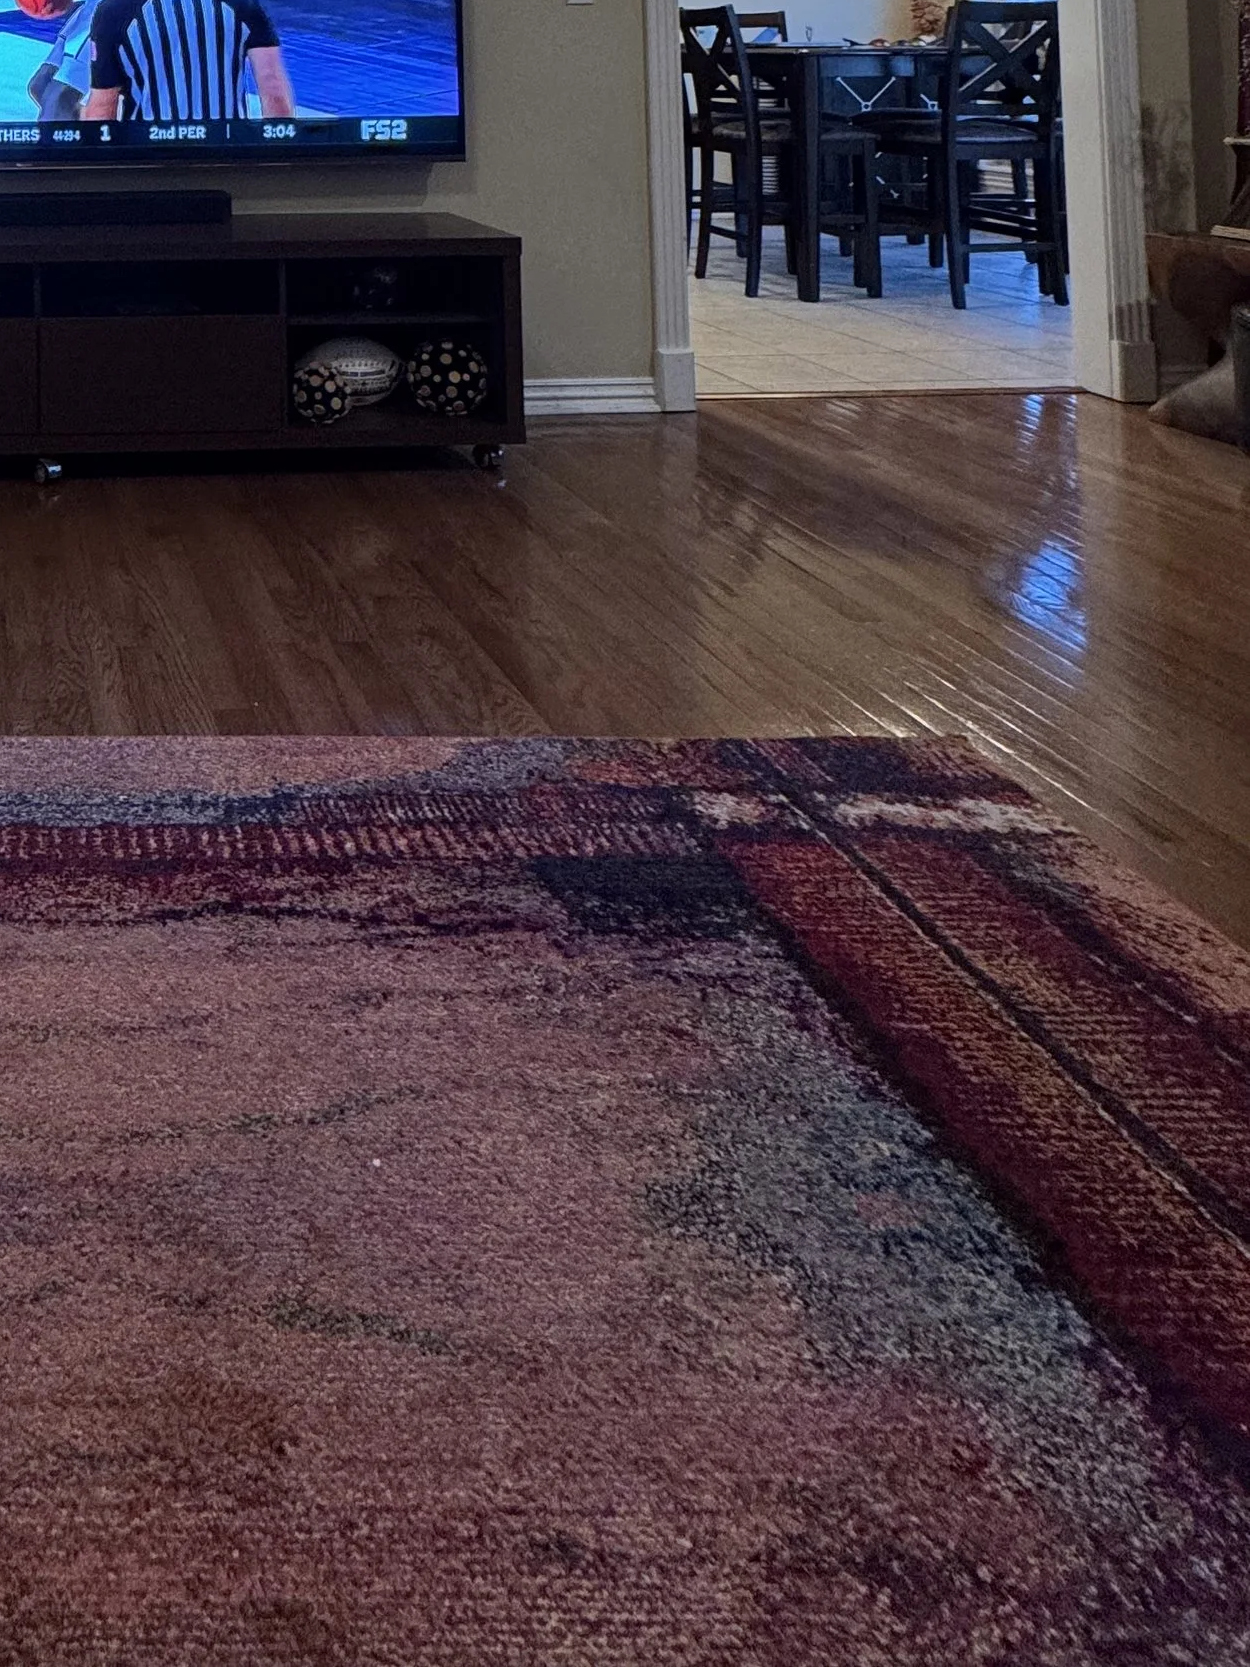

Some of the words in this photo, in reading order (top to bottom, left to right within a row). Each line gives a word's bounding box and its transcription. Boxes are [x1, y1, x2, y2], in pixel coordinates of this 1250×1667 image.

[100, 125, 111, 142] 1
[149, 126, 175, 140] 2nd
[178, 125, 207, 140] PER
[262, 124, 297, 139] 3:04
[360, 119, 408, 141] FS2
